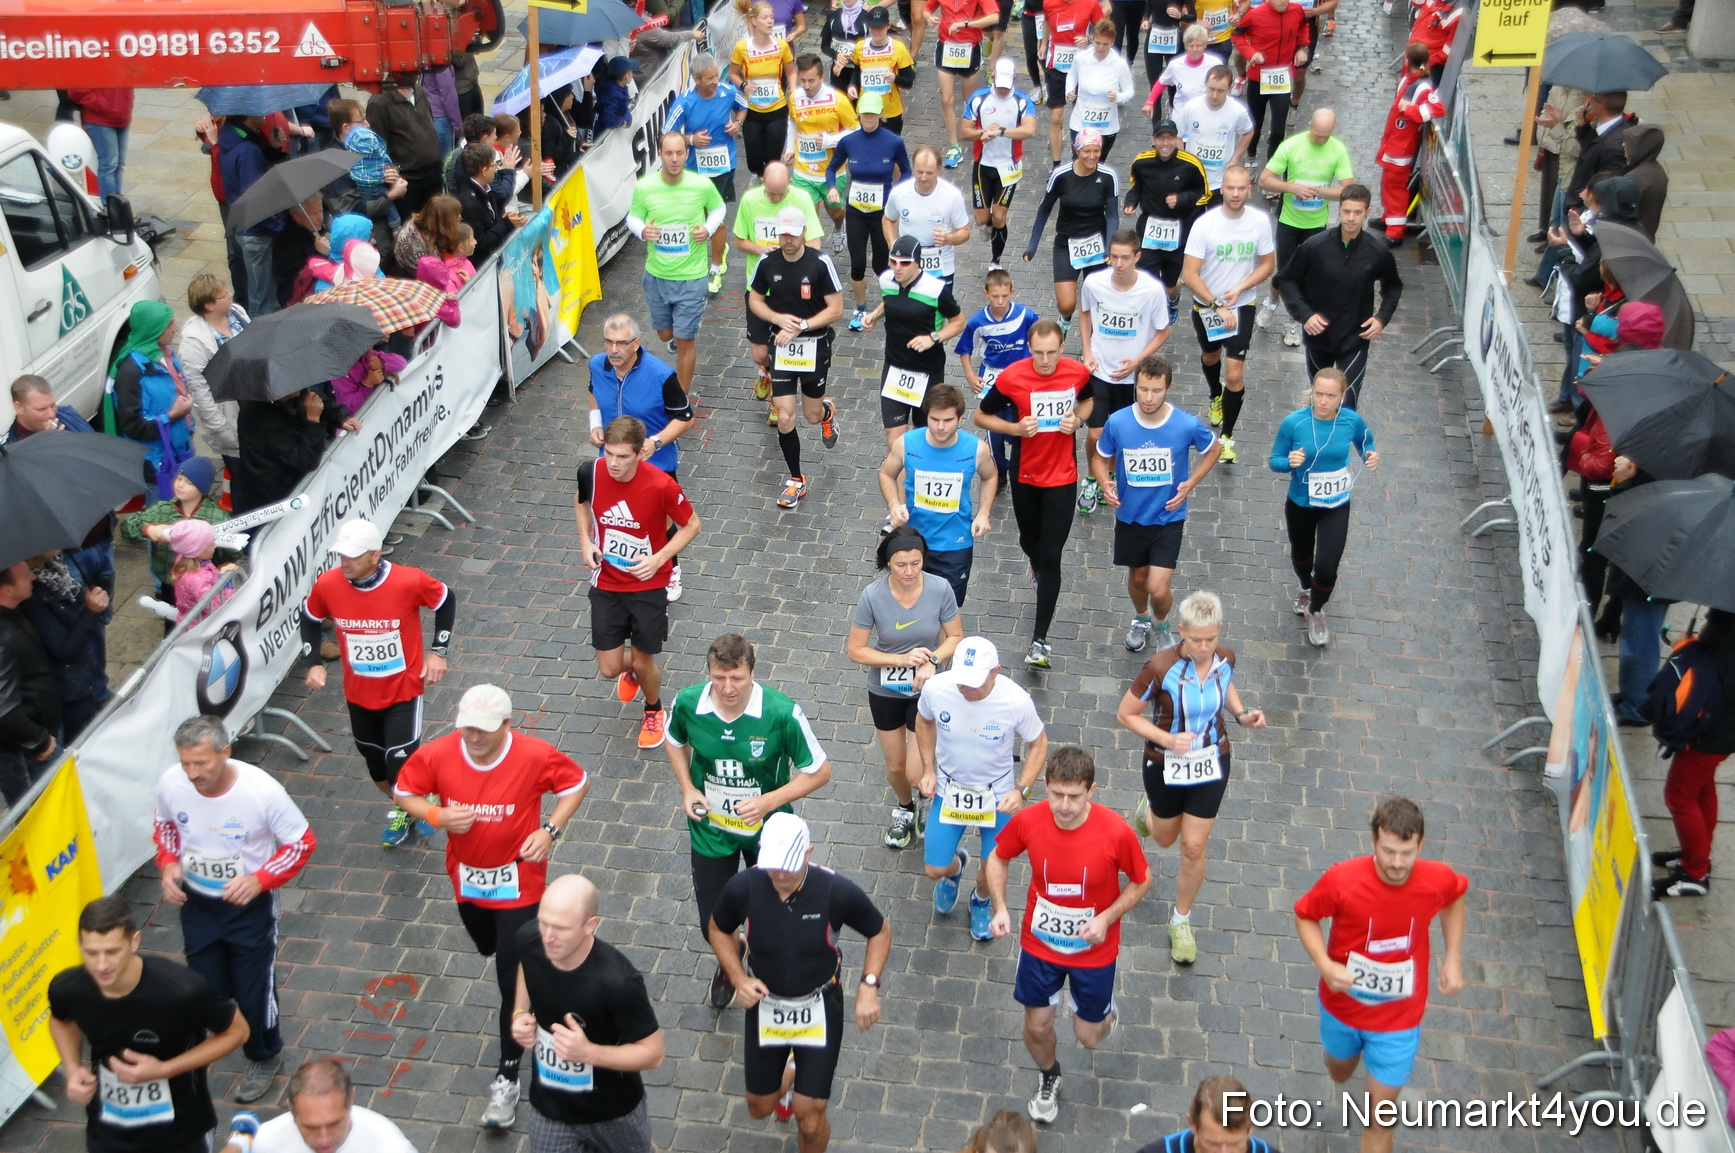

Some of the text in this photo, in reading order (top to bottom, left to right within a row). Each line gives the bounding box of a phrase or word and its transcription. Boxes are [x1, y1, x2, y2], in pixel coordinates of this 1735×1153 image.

[1499, 11, 1530, 26] lauf
[119, 33, 200, 57] 09181
[209, 31, 281, 55] 6352
[1151, 34, 1174, 46] 3191
[949, 47, 966, 58] 568
[1267, 74, 1285, 85] 186
[1084, 110, 1109, 122] 2247
[700, 154, 727, 167] 2080
[1196, 146, 1224, 160] 2392
[855, 191, 876, 204] 384
[1148, 225, 1175, 240] 2911
[1072, 241, 1101, 258] 2626
[1101, 313, 1134, 329] 2461
[788, 343, 804, 357] 94
[899, 373, 915, 390] 80
[1128, 458, 1167, 473] 2430
[1136, 474, 1161, 483] Gerhard
[1314, 476, 1348, 496] 2017
[369, 473, 395, 516] Mehr
[924, 481, 953, 498] 137
[924, 498, 949, 509] Andreas
[599, 515, 641, 530] adidas
[609, 539, 649, 560] 2075
[256, 536, 308, 633] BMW
[336, 619, 390, 630] NEUMARKT
[353, 642, 398, 662] 2380
[367, 664, 388, 673] Erwin
[1171, 759, 1214, 781] 2198
[952, 792, 984, 810] 191
[724, 817, 744, 829] Horst
[950, 811, 985, 821] Christoph
[188, 855, 238, 880] 3195
[465, 865, 513, 886] 2375
[1048, 936, 1074, 948] Martin
[1353, 968, 1404, 994] 2331
[773, 1008, 812, 1025] 540
[104, 1081, 162, 1106] 2878
